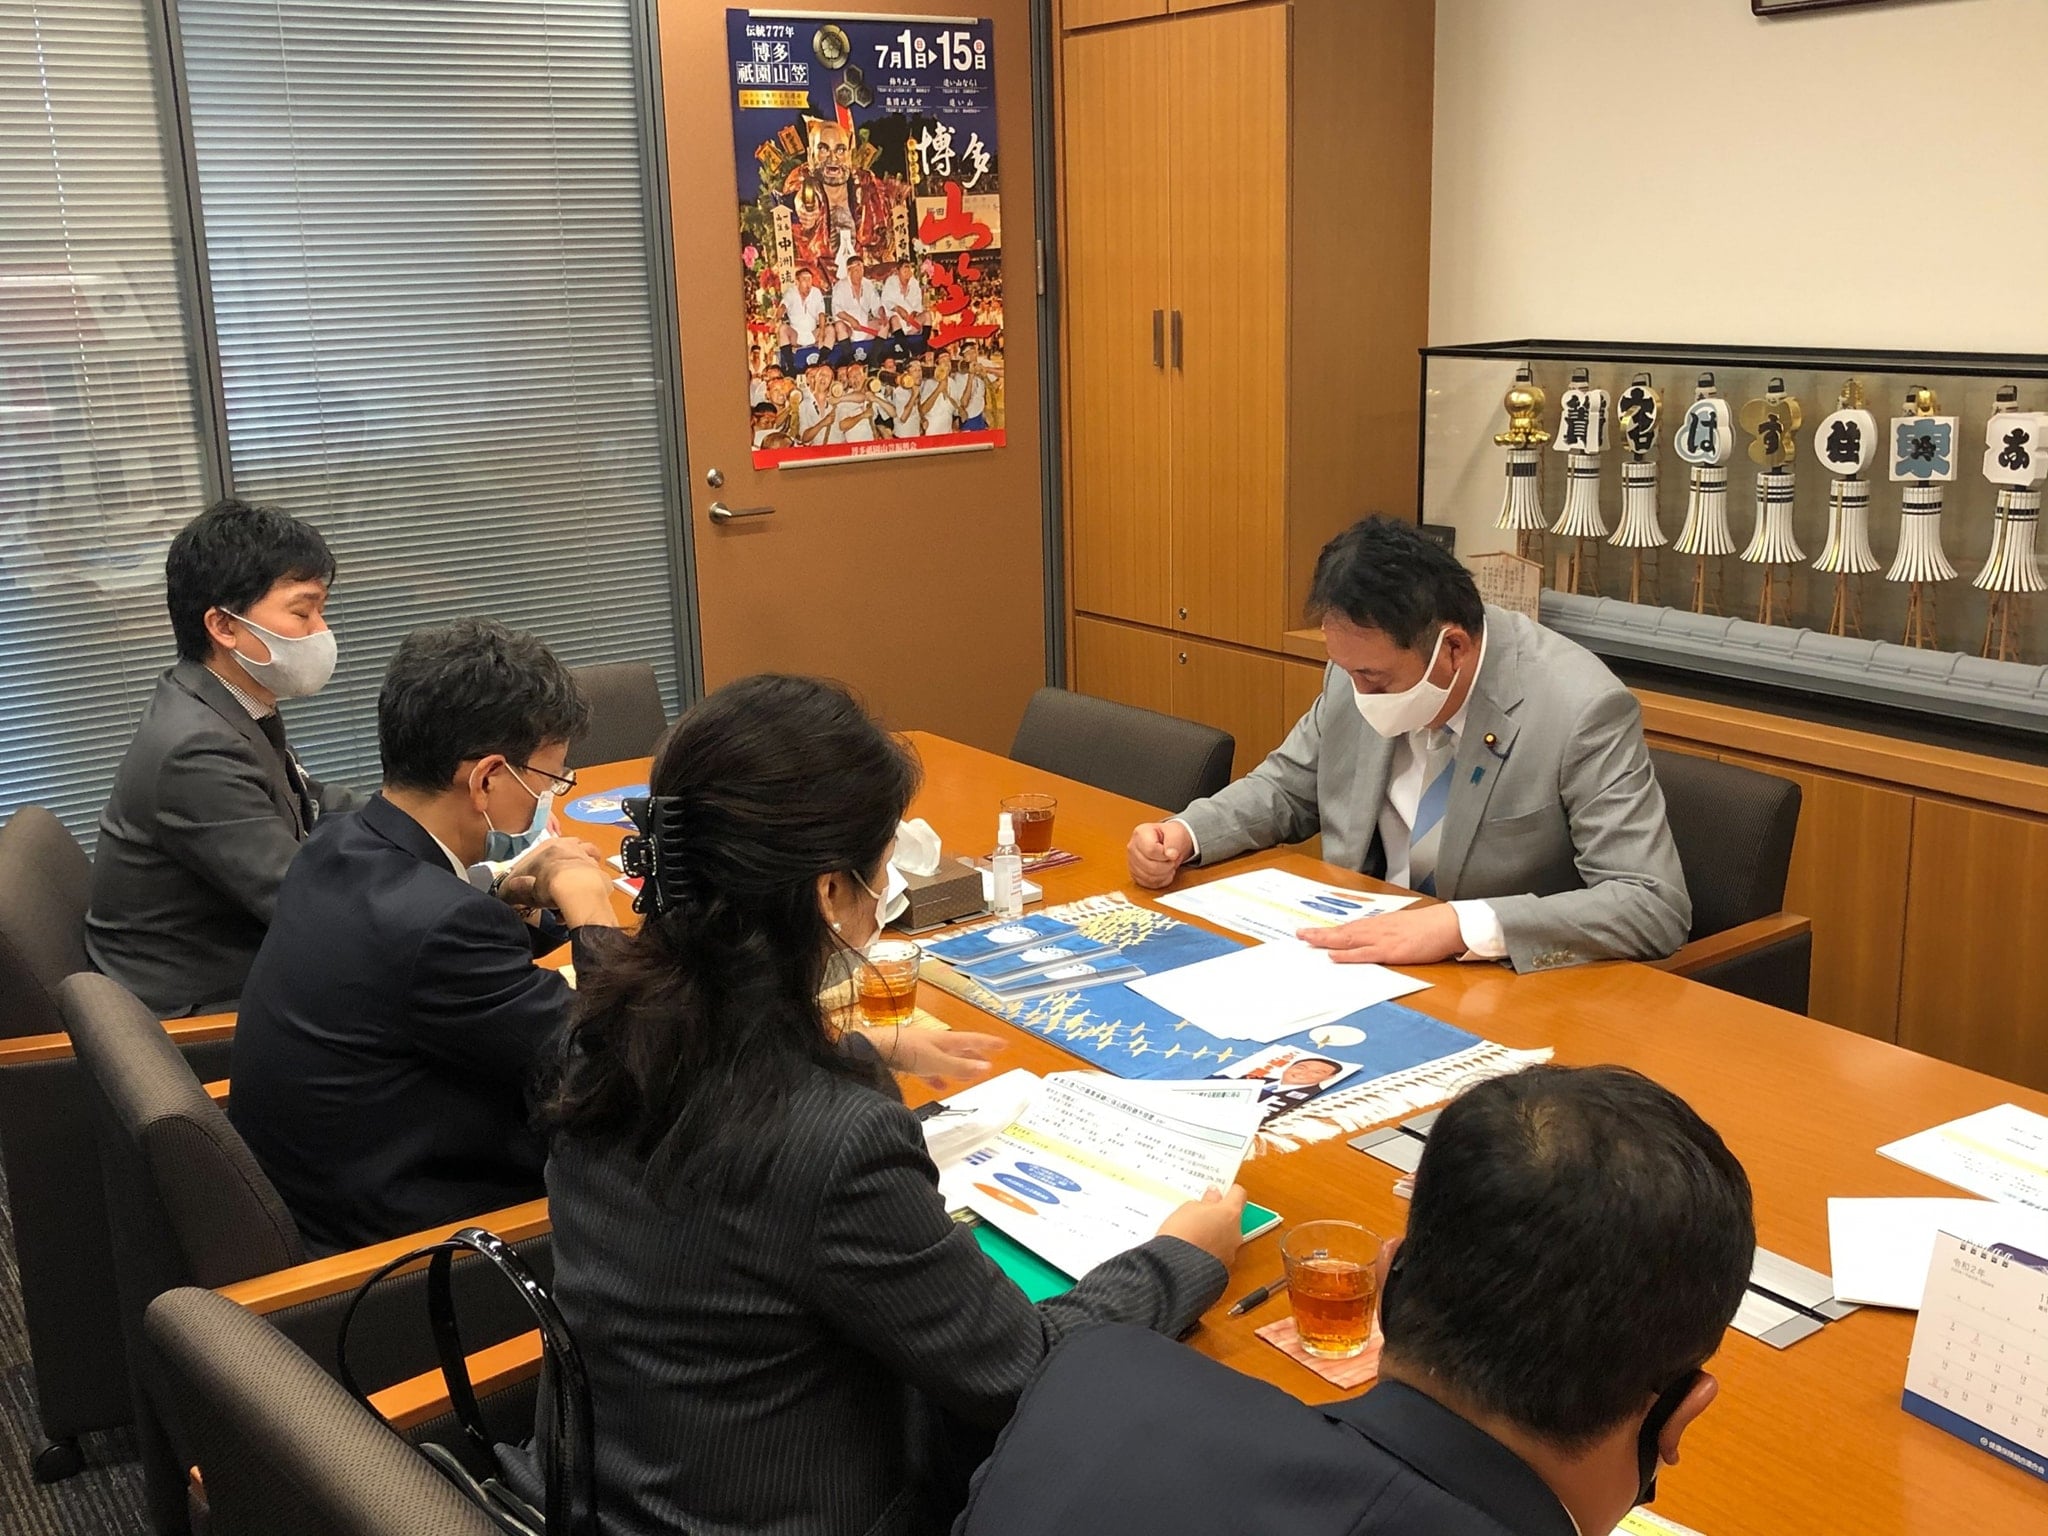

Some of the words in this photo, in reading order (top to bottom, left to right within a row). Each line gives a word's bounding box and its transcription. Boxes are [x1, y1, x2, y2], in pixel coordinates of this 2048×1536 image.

[746, 24, 795, 38] 伝統777年
[753, 42, 789, 63] 博多
[738, 64, 807, 83] 祇園山笠
[916, 121, 991, 188] 博多
[778, 236, 795, 284] 中洲流
[1687, 411, 1718, 456] は
